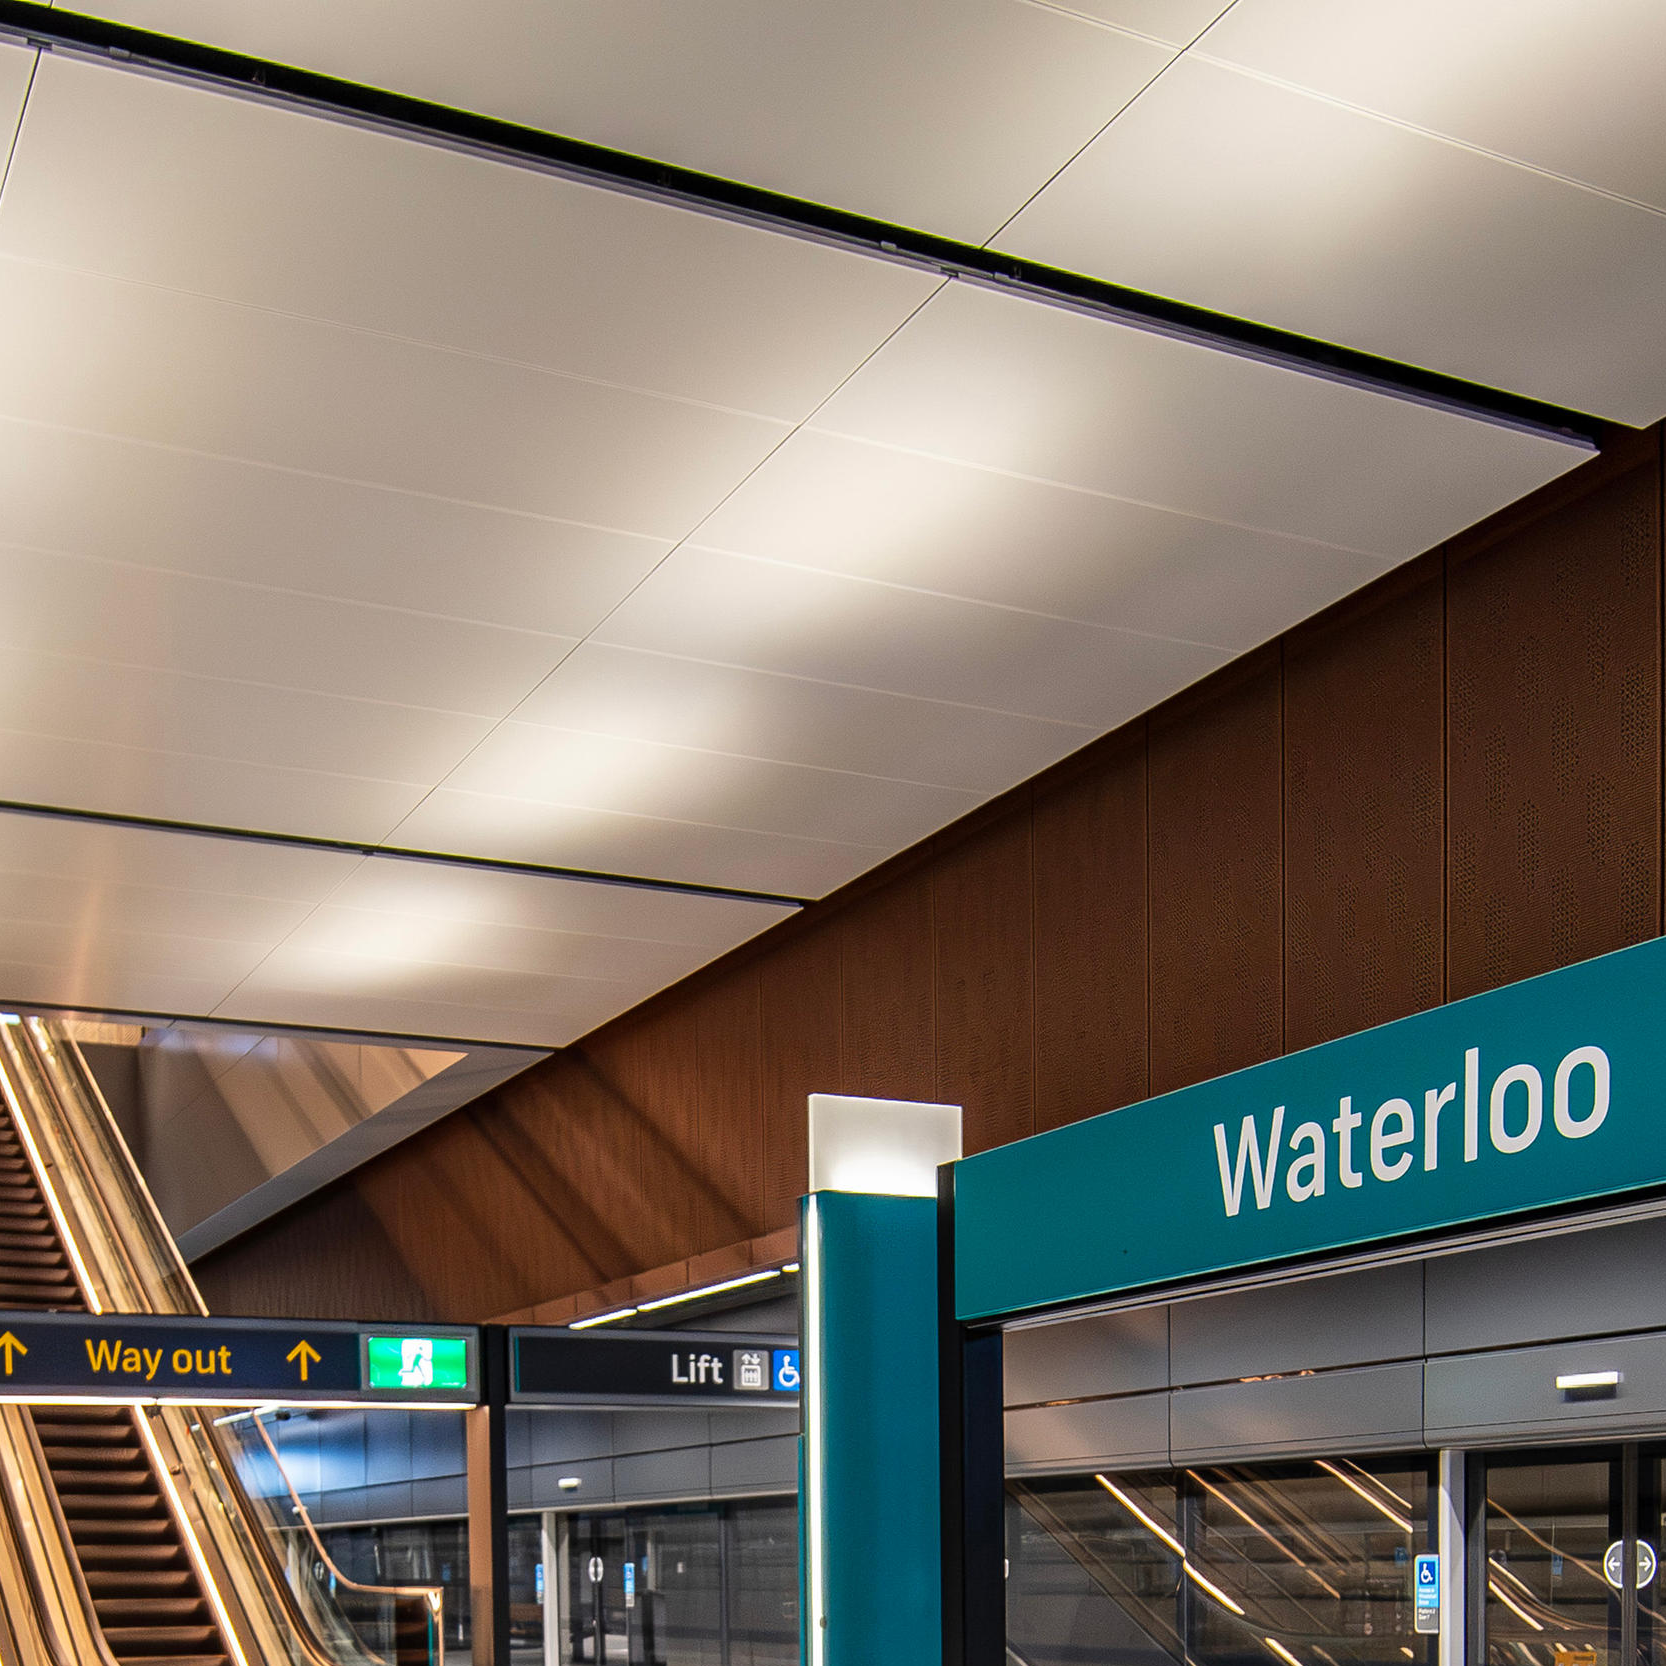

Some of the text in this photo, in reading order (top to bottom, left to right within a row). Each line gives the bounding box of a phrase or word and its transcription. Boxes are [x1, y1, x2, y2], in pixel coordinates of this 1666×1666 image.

[1213, 1045, 1610, 1217] Waterloo
[84, 1337, 233, 1381] Way out
[671, 1352, 725, 1385] Lift
